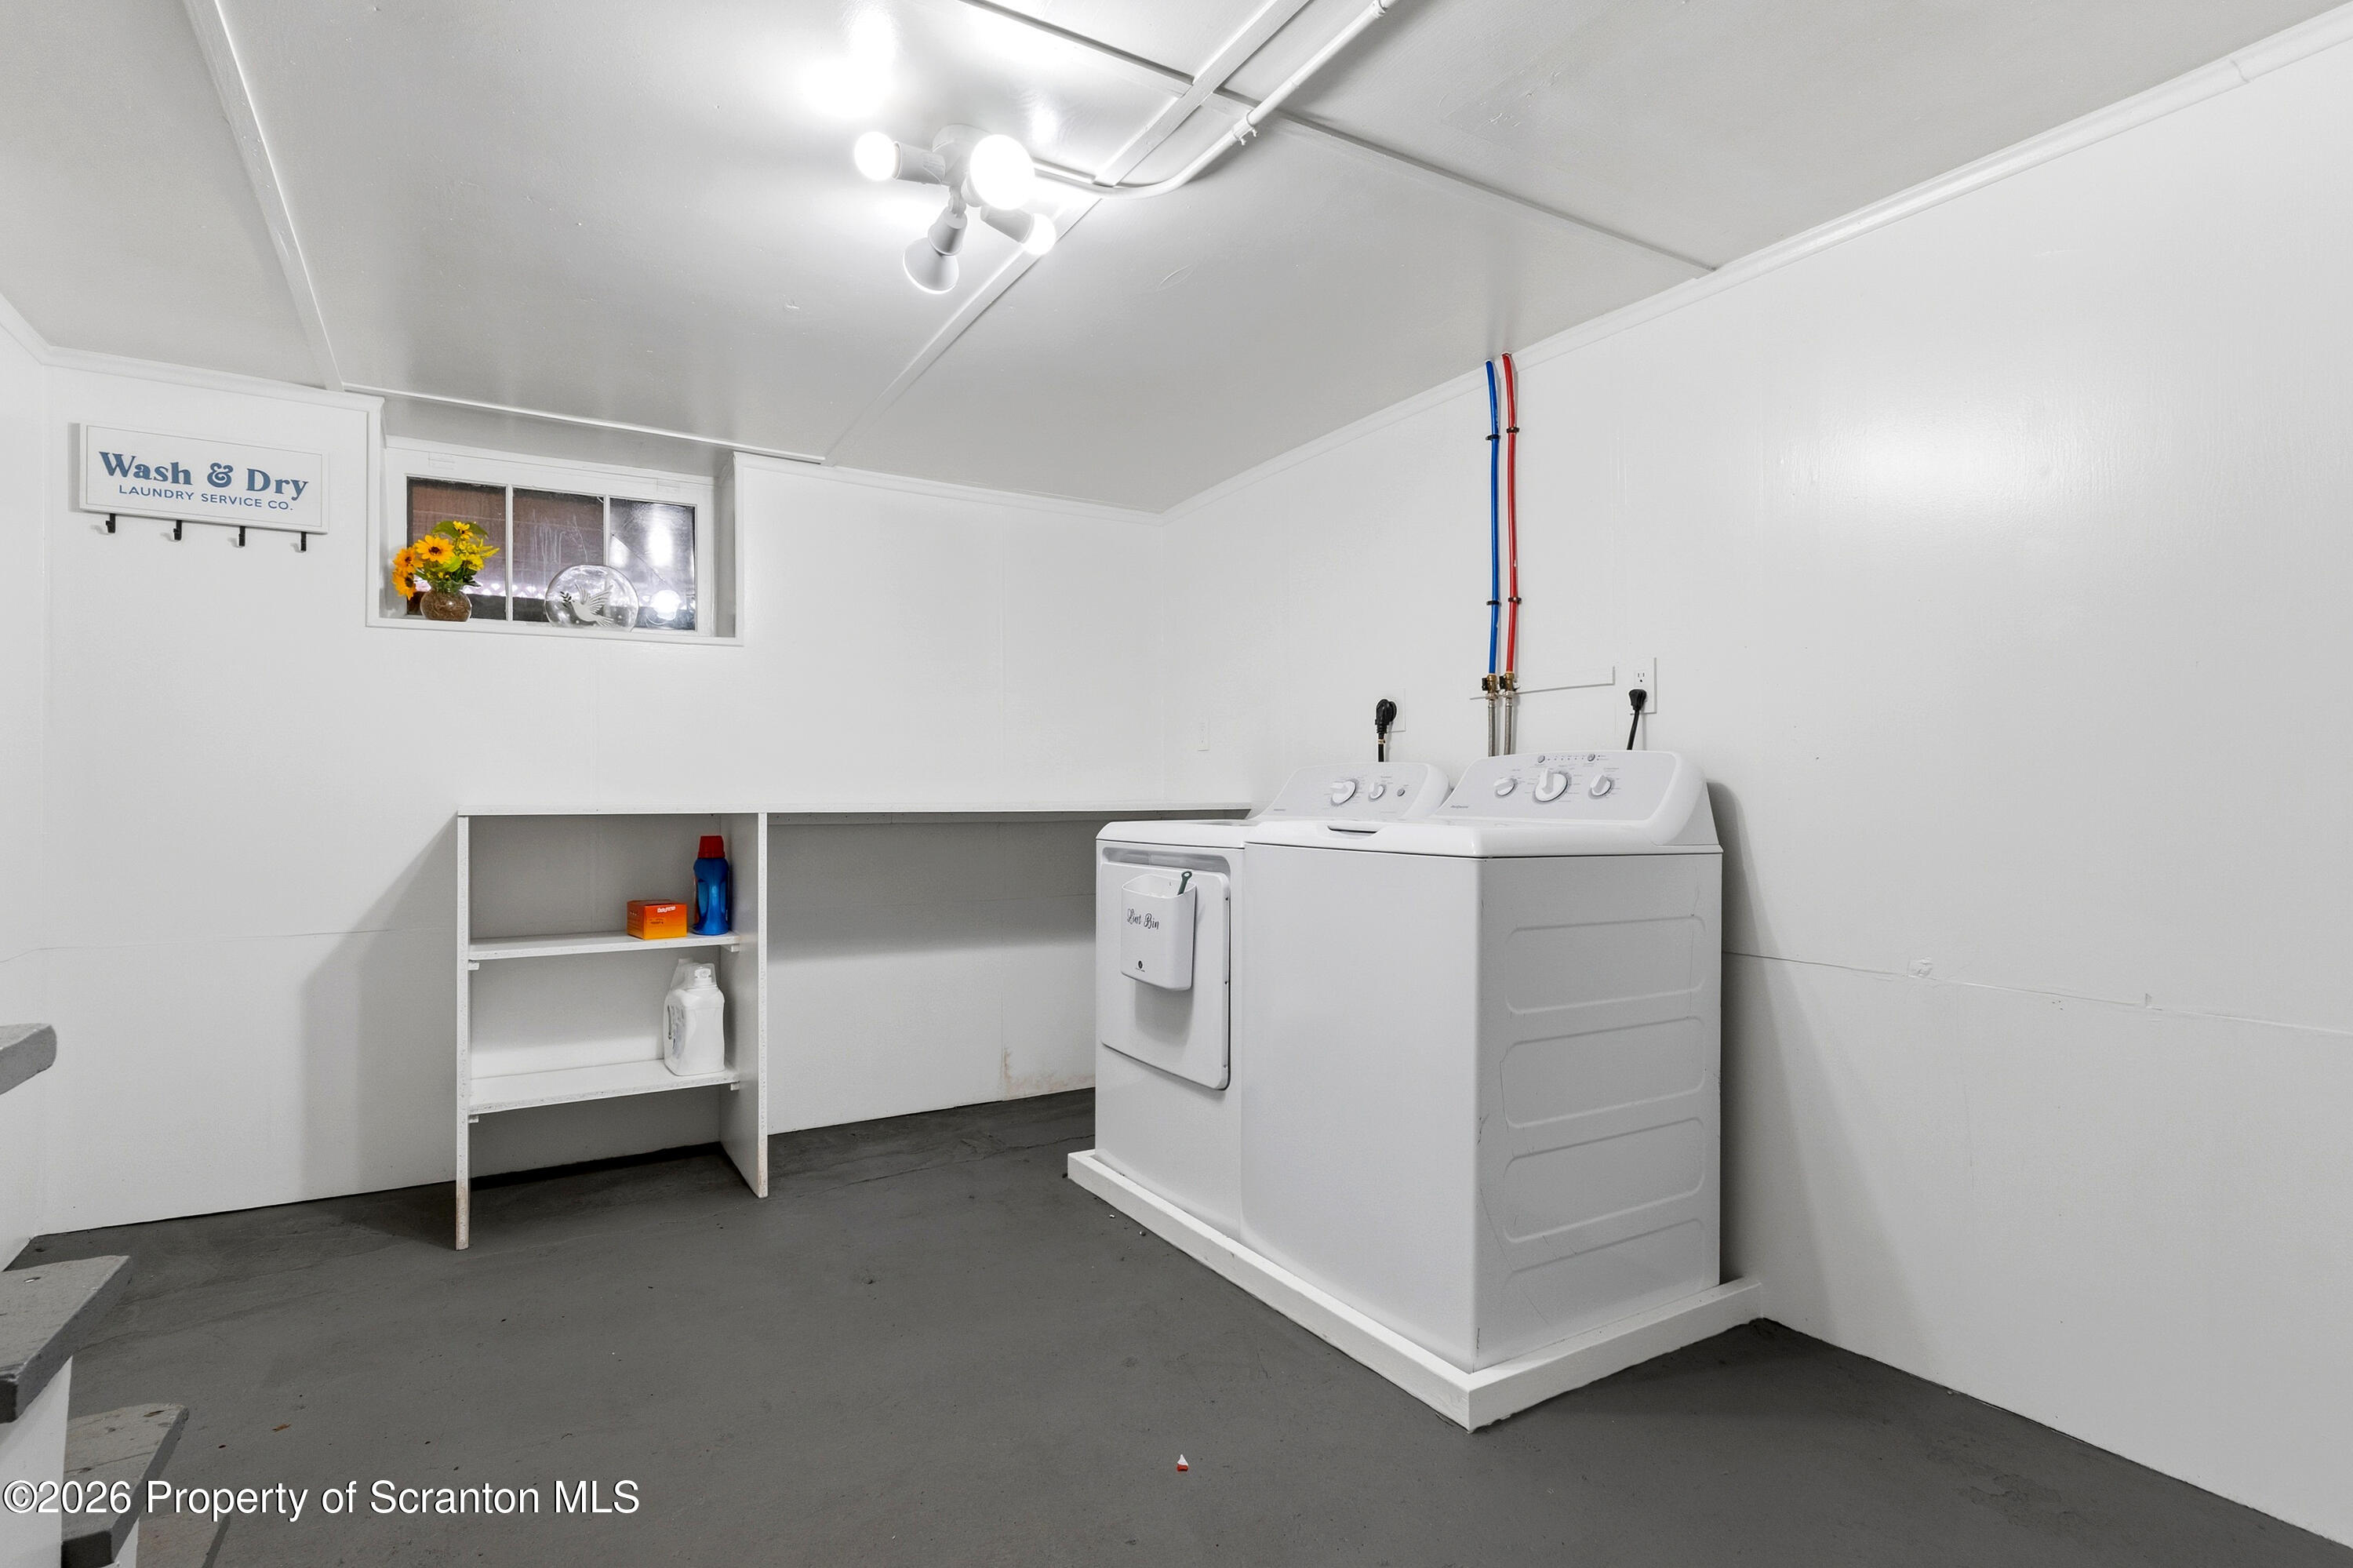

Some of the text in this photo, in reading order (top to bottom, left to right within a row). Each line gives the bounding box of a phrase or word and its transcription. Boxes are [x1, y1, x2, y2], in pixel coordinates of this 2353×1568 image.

[99, 451, 309, 500] Wash & Dry
[119, 484, 293, 511] LAUNDRY SERVICE CO.
[1144, 913, 1159, 930] Bin
